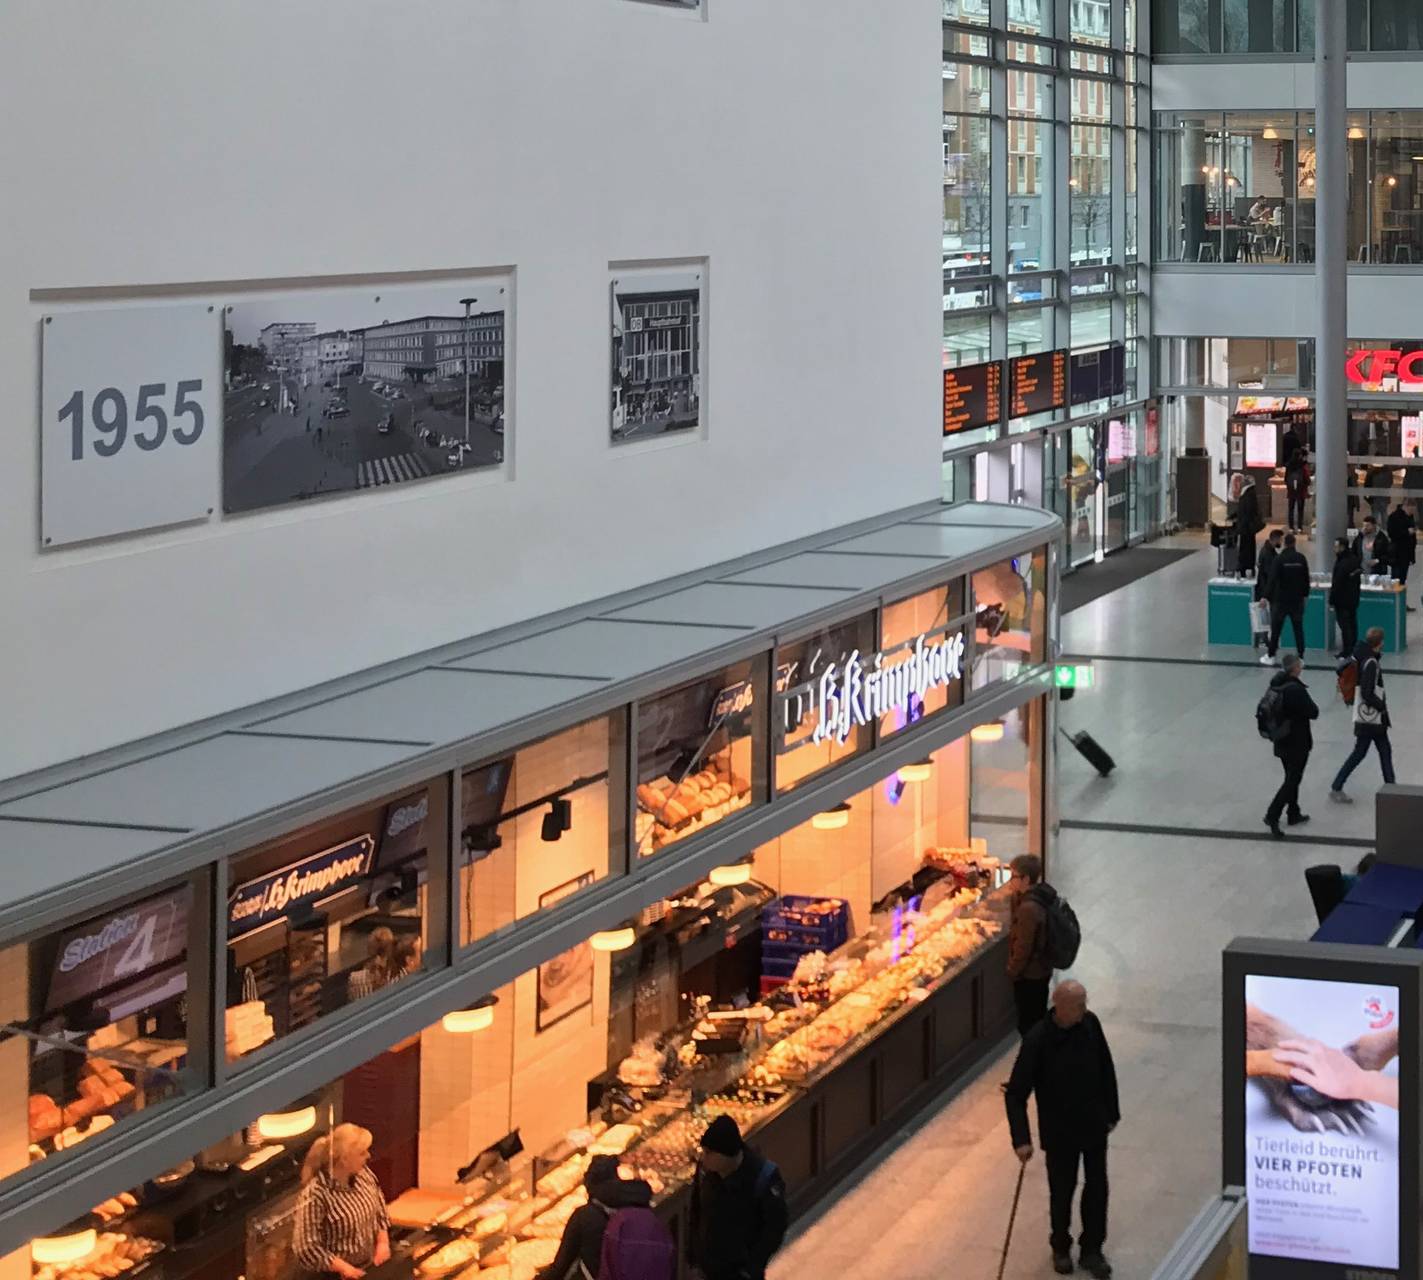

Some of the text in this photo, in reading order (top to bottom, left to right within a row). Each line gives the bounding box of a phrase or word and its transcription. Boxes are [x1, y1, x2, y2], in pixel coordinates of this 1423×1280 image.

[58, 379, 204, 461] 1955
[114, 914, 157, 977] 4
[1255, 1137, 1384, 1162] Tierleid berührt.
[1254, 1156, 1363, 1179] VIER PFOTEN
[1255, 1174, 1338, 1196] beschützt.
